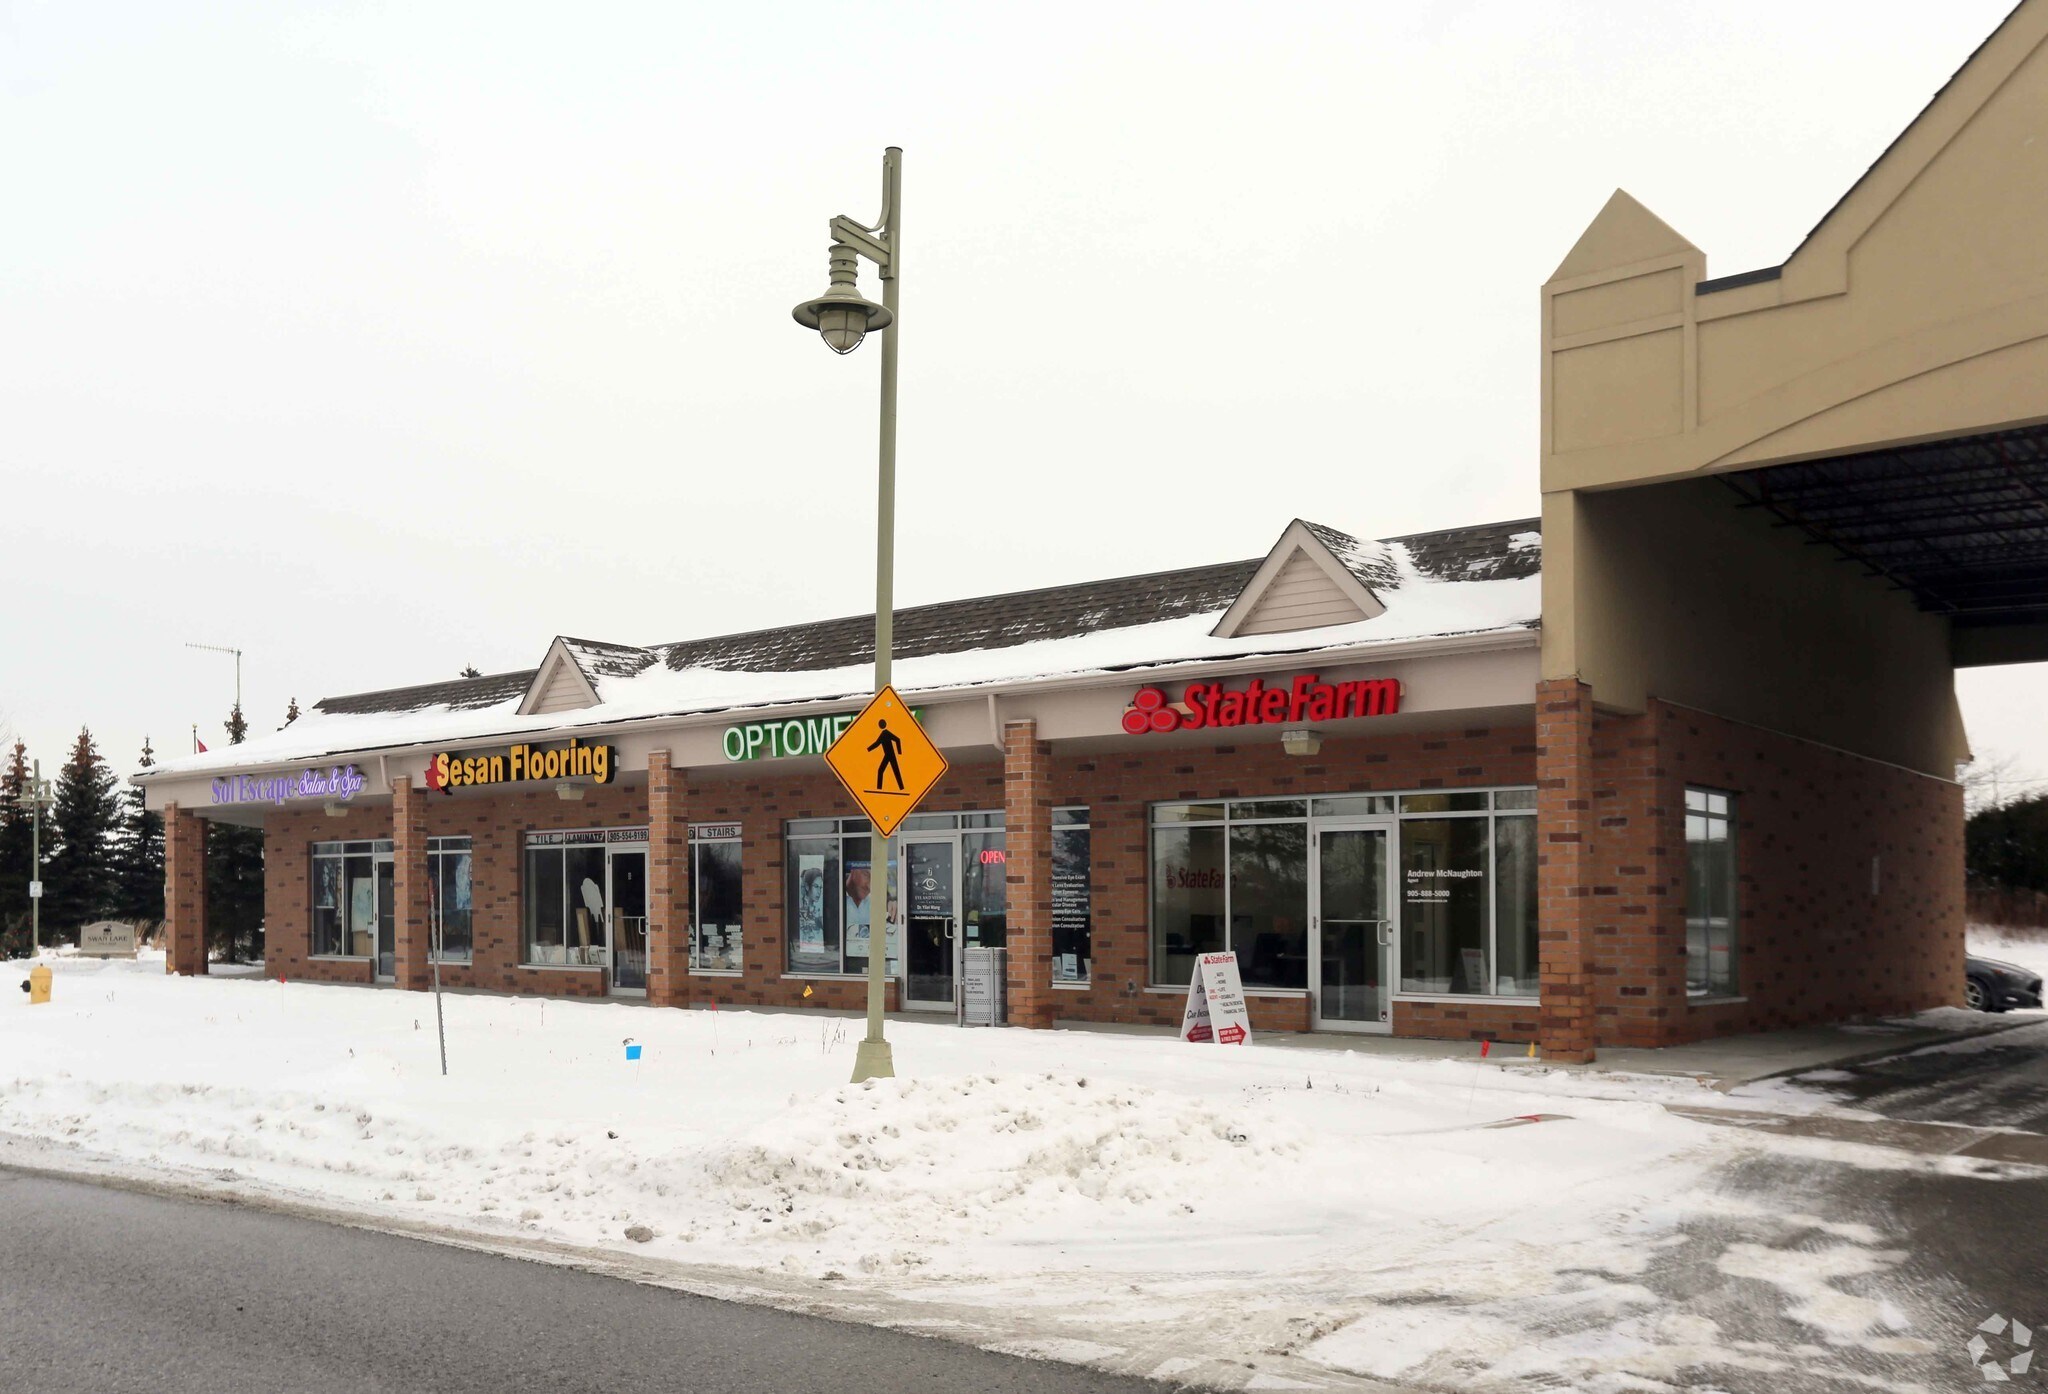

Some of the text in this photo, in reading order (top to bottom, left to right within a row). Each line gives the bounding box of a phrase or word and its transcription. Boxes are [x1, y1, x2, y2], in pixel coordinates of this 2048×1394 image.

[724, 711, 917, 761] OPTOME
[437, 737, 610, 787] Sesan Flooring
[211, 764, 362, 805] Sol Escape Salon & Spa
[707, 827, 736, 837] STAIRS
[536, 834, 553, 843] TILE
[980, 850, 1006, 864] OPEN
[1407, 869, 1483, 879] Andrew McNaughton
[1406, 889, 1451, 897] 905-888-5000
